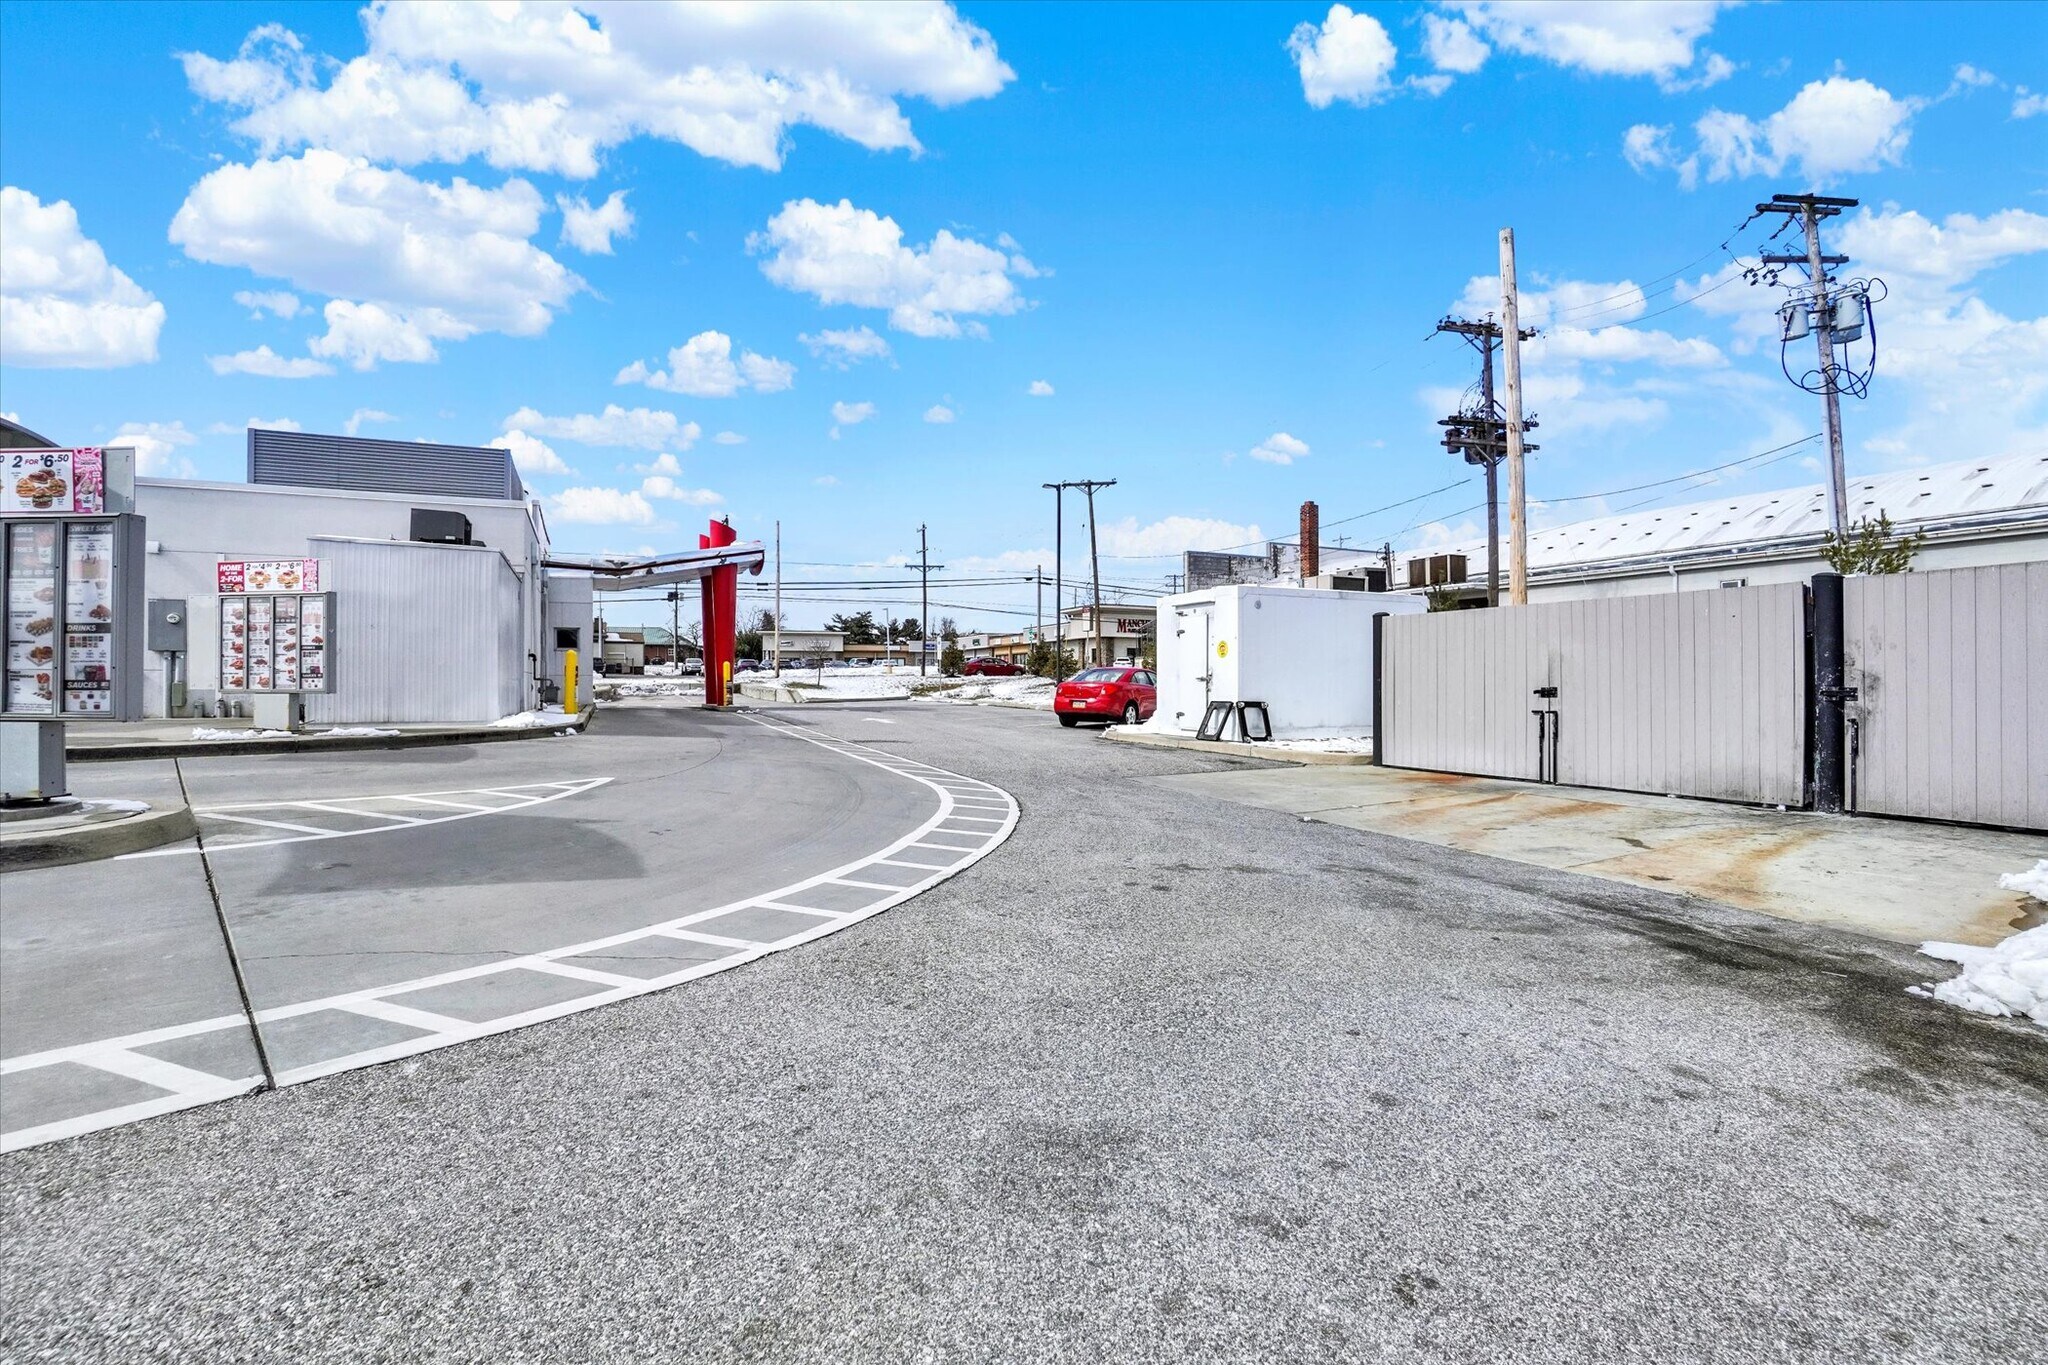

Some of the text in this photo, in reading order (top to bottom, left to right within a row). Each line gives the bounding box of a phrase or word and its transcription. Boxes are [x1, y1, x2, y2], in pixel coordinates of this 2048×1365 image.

[12, 455, 22, 468] 2
[70, 524, 95, 532] SWEET
[220, 564, 243, 572] HOME
[220, 575, 243, 583] 2-FOR
[66, 624, 97, 632] DRINKS
[66, 681, 98, 689] SAUCES
